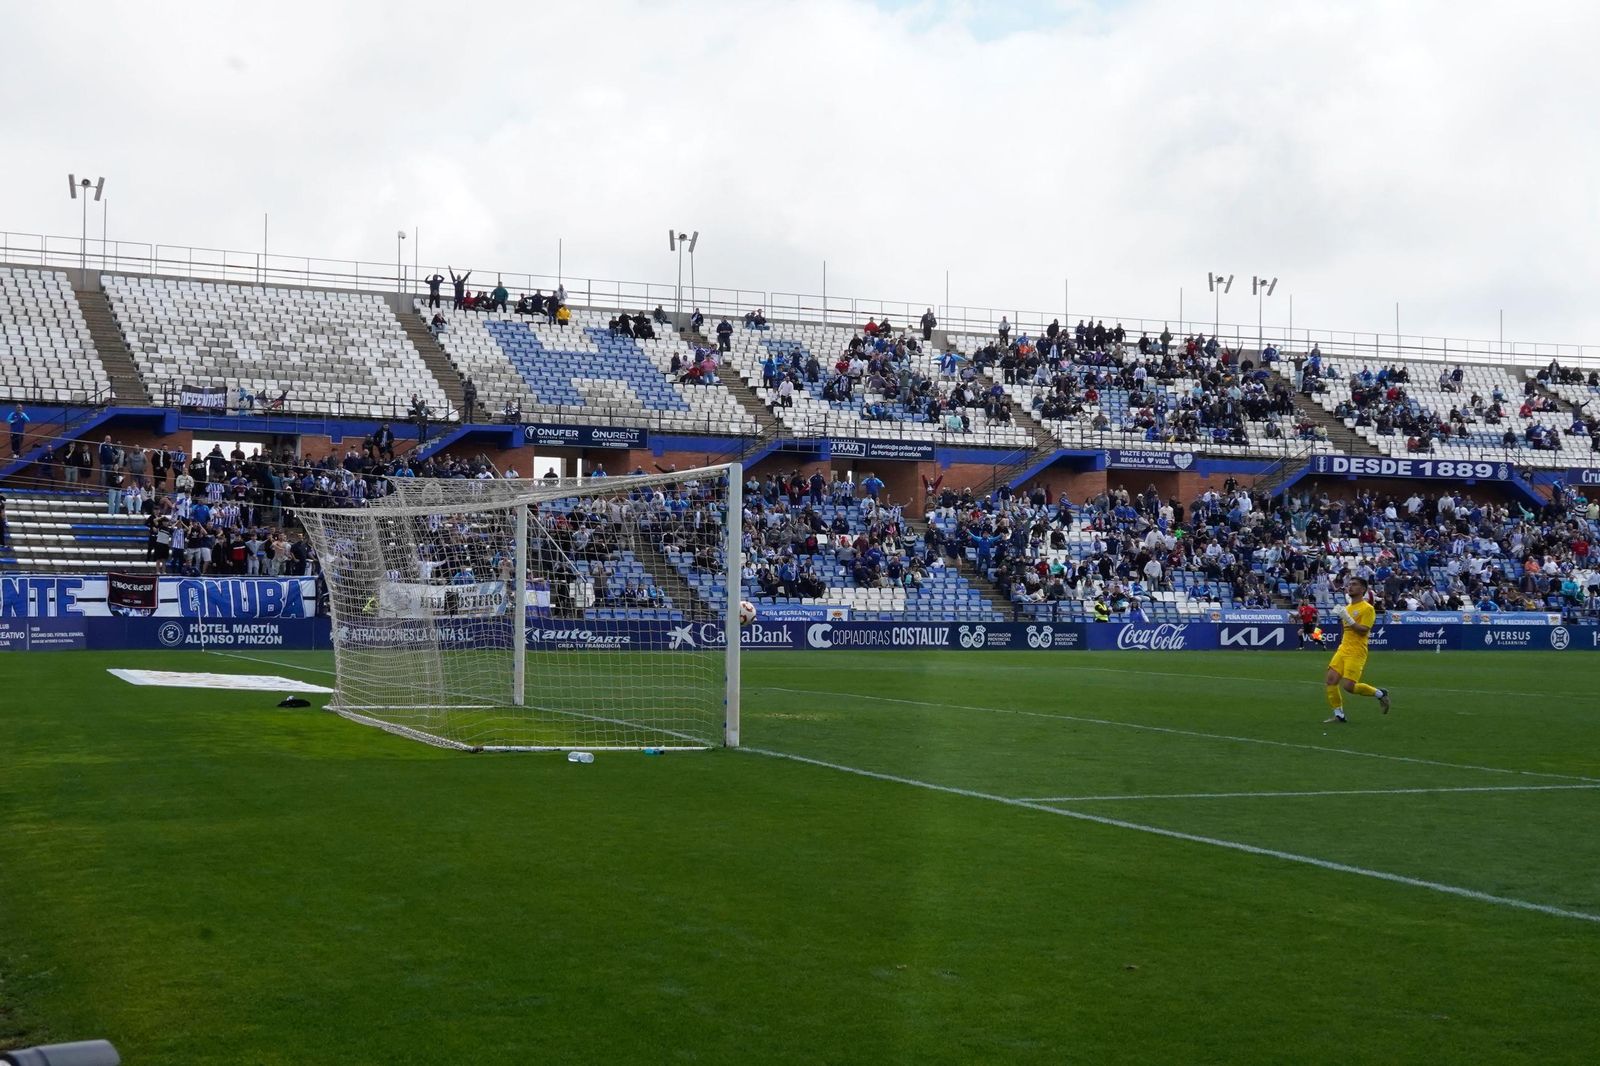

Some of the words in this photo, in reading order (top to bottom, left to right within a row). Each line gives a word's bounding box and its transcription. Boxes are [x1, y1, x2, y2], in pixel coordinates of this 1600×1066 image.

[537, 428, 579, 437] ONUFER
[838, 443, 859, 452] PLAZA
[1333, 457, 1412, 476] DESDE
[1418, 461, 1493, 478] 1889
[176, 578, 306, 618] ONUBA
[190, 624, 230, 634] HOTEL
[232, 622, 279, 634] MARTÍN
[700, 623, 793, 643] CaaBank
[1419, 630, 1435, 638] alter
[185, 634, 234, 644] ALONSO
[238, 633, 283, 645] PINZÓN
[832, 630, 890, 646] COPIADORAS
[892, 627, 949, 646] COSTALUZ
[1117, 623, 1188, 650] Coca-Cola
[1220, 626, 1284, 646] KIA
[1494, 632, 1531, 640] VERSUS
